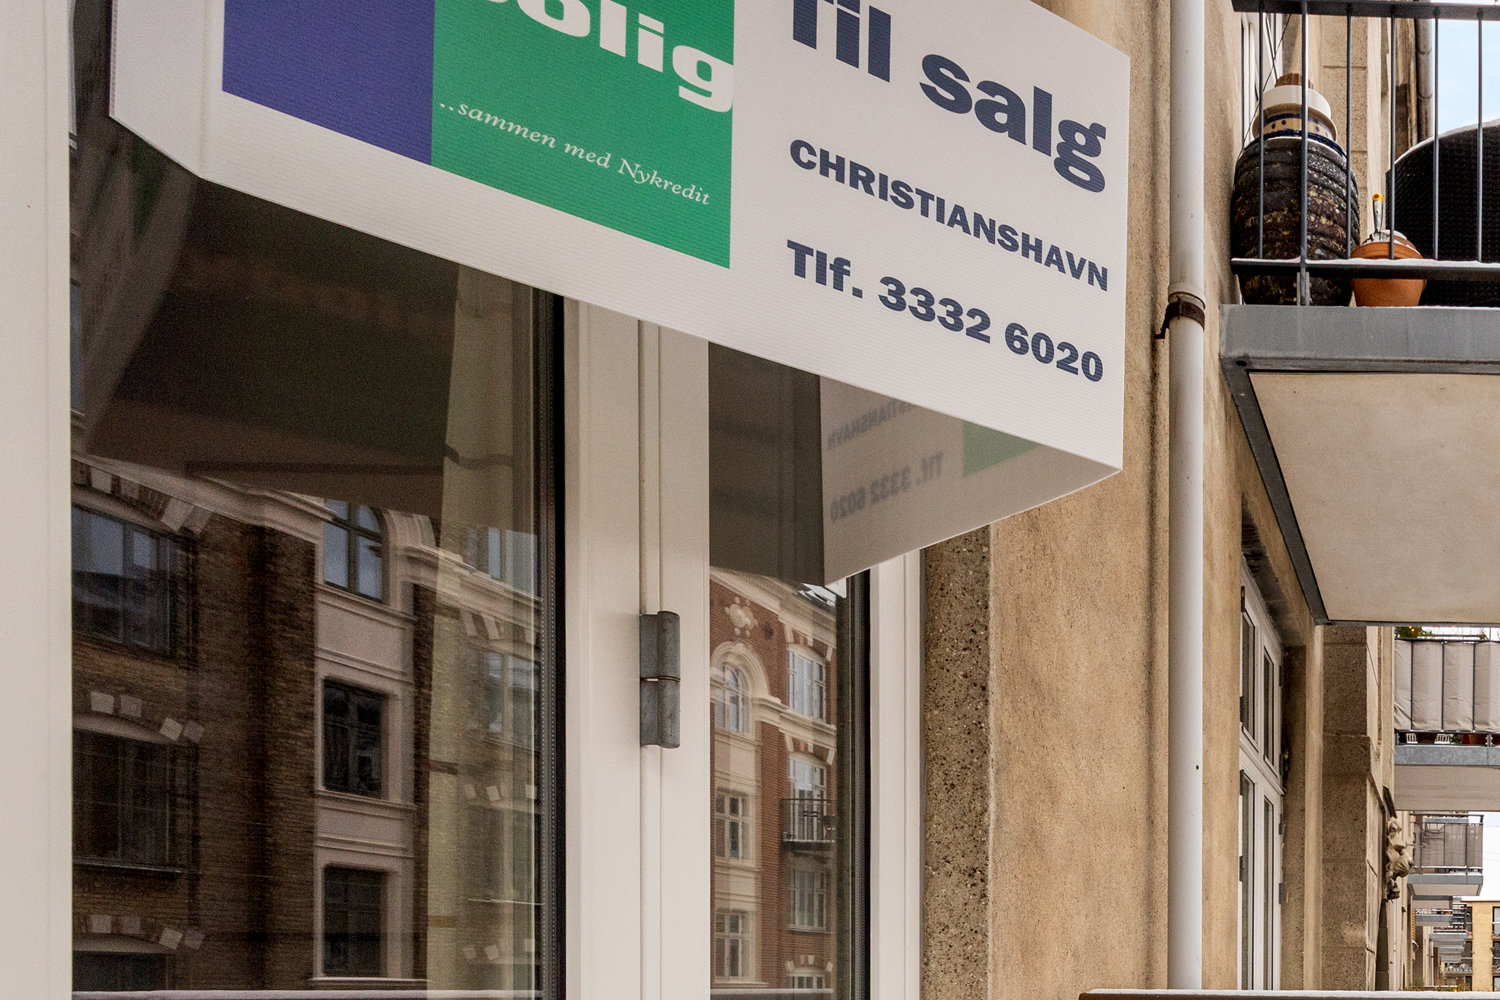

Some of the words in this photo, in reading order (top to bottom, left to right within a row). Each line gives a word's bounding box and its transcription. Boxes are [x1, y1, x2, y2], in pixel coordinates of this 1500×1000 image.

[488, 0, 735, 113] olig
[919, 54, 1107, 193] salg
[564, 141, 611, 169] med
[618, 157, 711, 206] Nykredit
[789, 139, 1108, 291] CHRISTIANSHAVN
[786, 239, 863, 299] Tlf.
[878, 276, 991, 344] 3332
[1004, 322, 1104, 383] 6020
